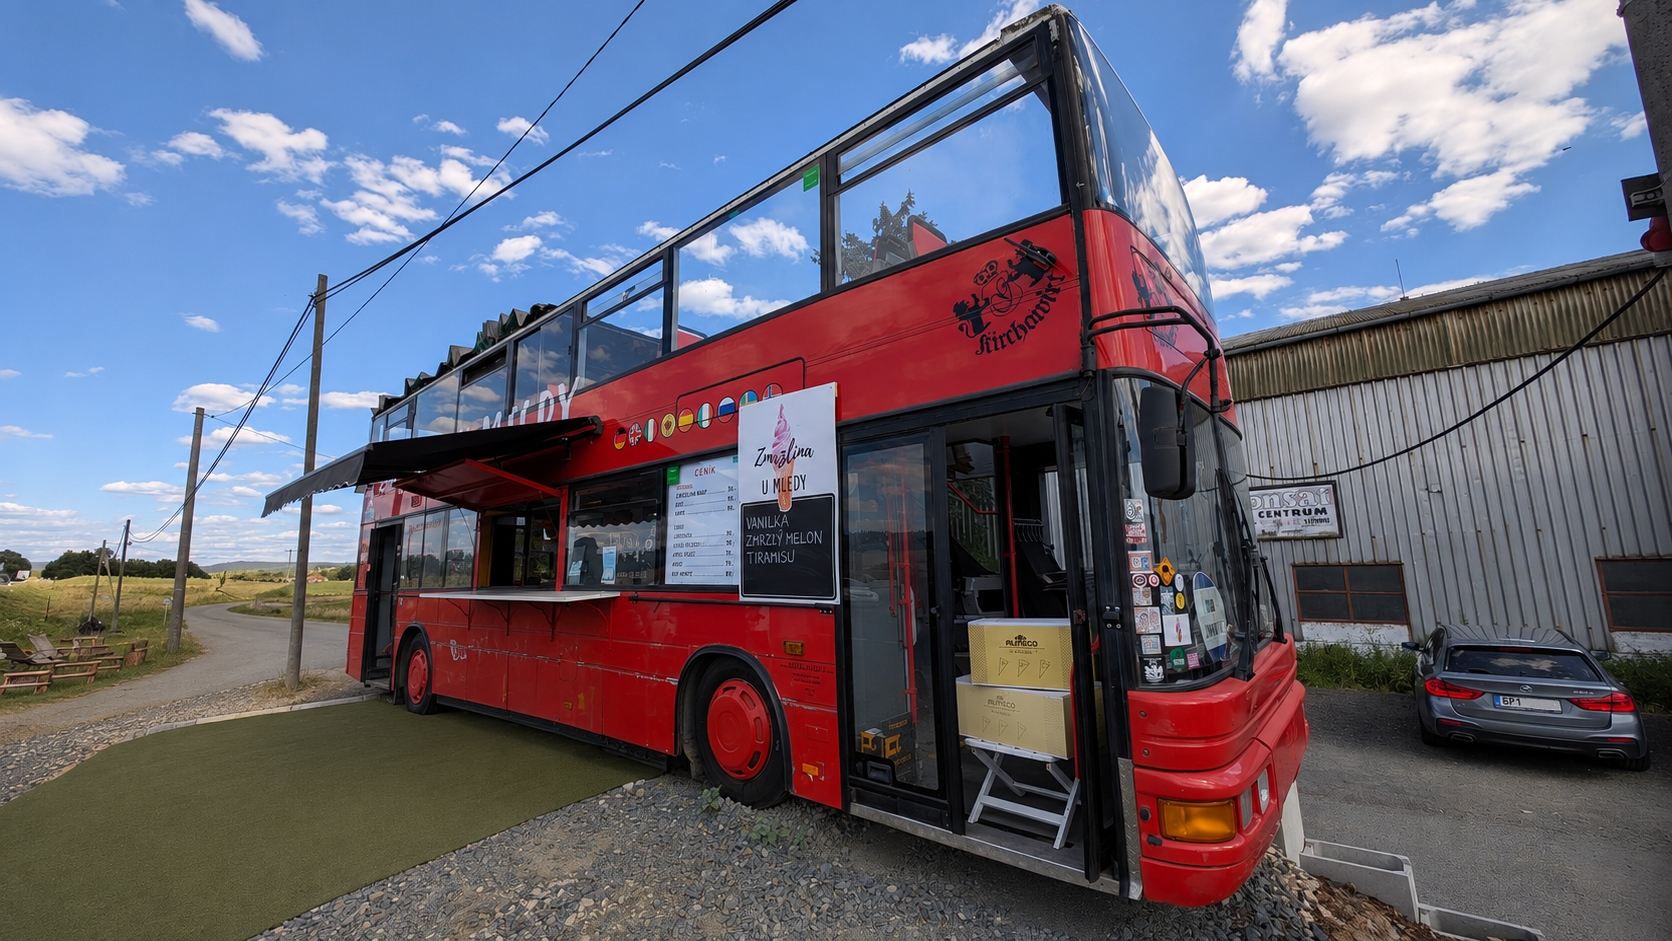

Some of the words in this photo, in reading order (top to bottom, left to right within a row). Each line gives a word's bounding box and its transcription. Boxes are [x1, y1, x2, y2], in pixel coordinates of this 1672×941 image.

[694, 464, 716, 477] CENÍK
[762, 479, 769, 495] U
[773, 474, 807, 494] MLEDY
[1258, 507, 1328, 518] CENTRUM
[746, 514, 790, 530] VANILKA
[785, 530, 823, 545] MELON
[746, 550, 796, 565] TIRAMISU
[1502, 697, 1521, 706] 6P1
